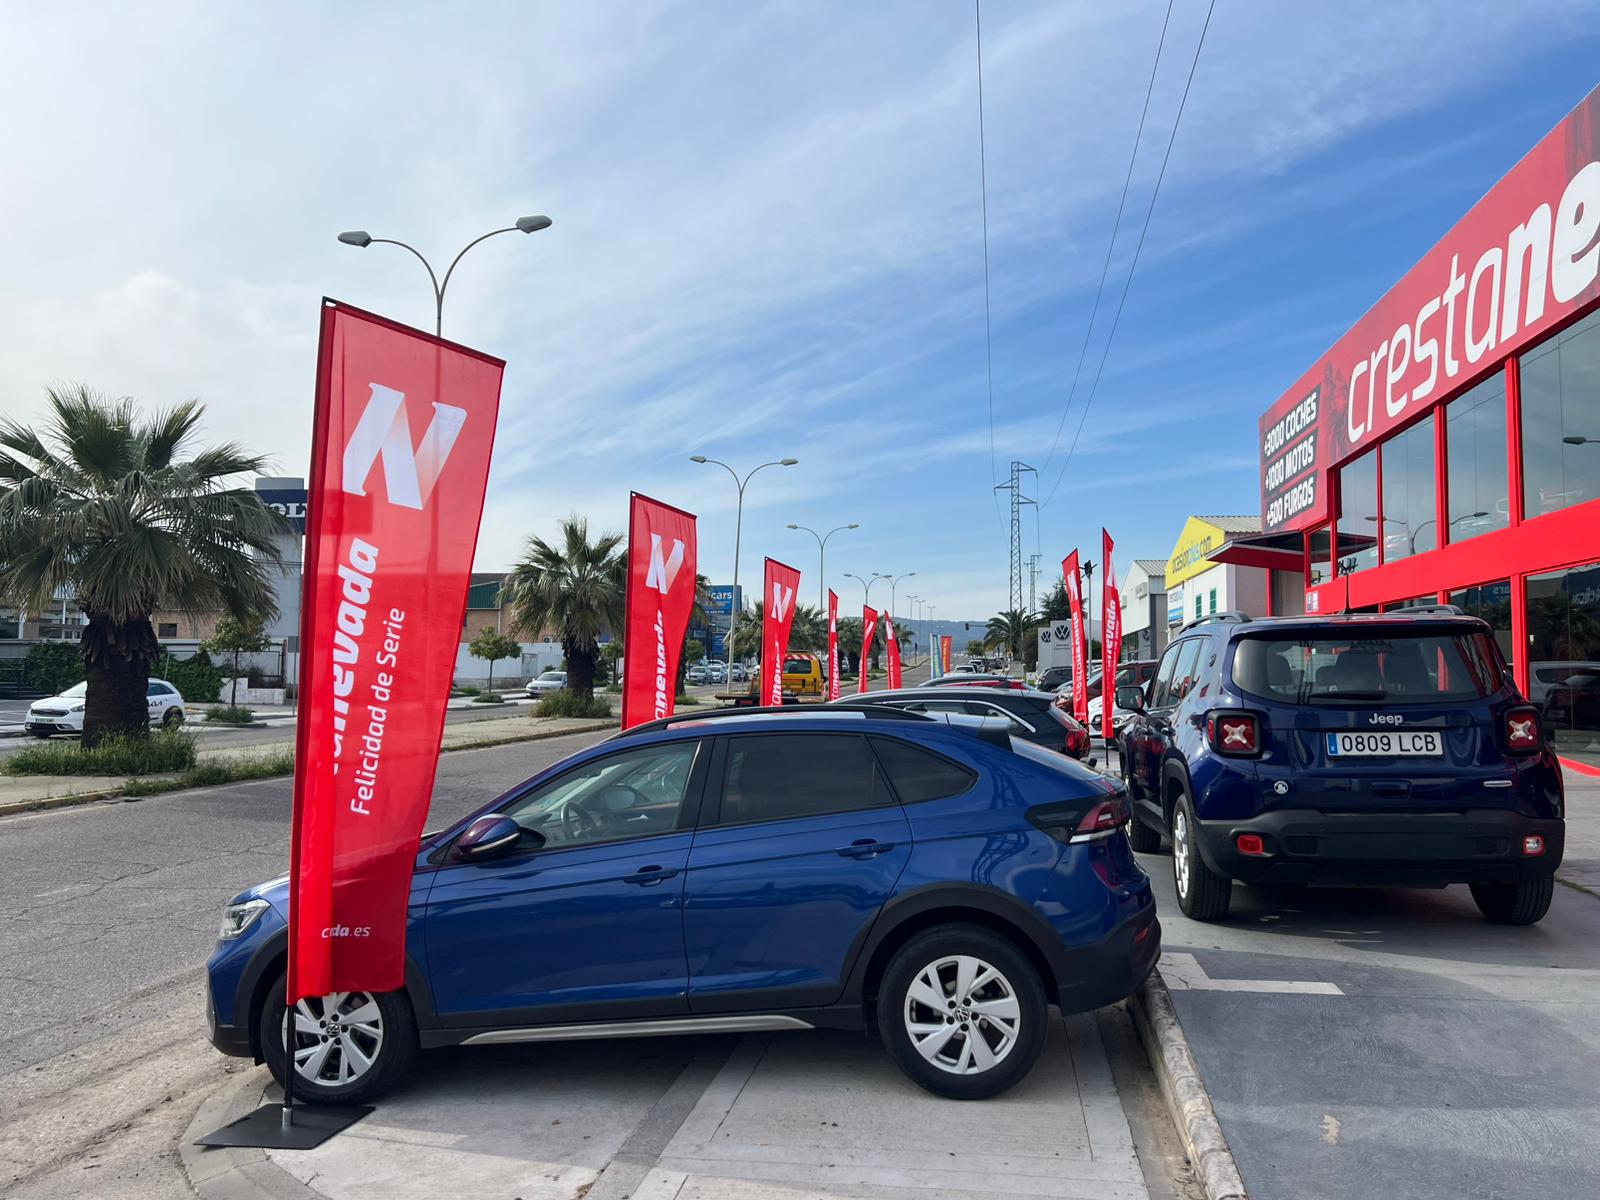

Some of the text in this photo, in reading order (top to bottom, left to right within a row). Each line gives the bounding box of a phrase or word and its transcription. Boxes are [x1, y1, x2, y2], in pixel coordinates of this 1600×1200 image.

[1347, 161, 1600, 443] crestane
[1264, 391, 1317, 457] +3000 COCHES
[1265, 435, 1314, 491] +1000 MOTOS
[1267, 476, 1314, 527] +500 FURGOS
[350, 607, 405, 816] Felicidad de Serie
[1368, 713, 1404, 726] Jeep
[1341, 734, 1437, 753] 0809 LCB
